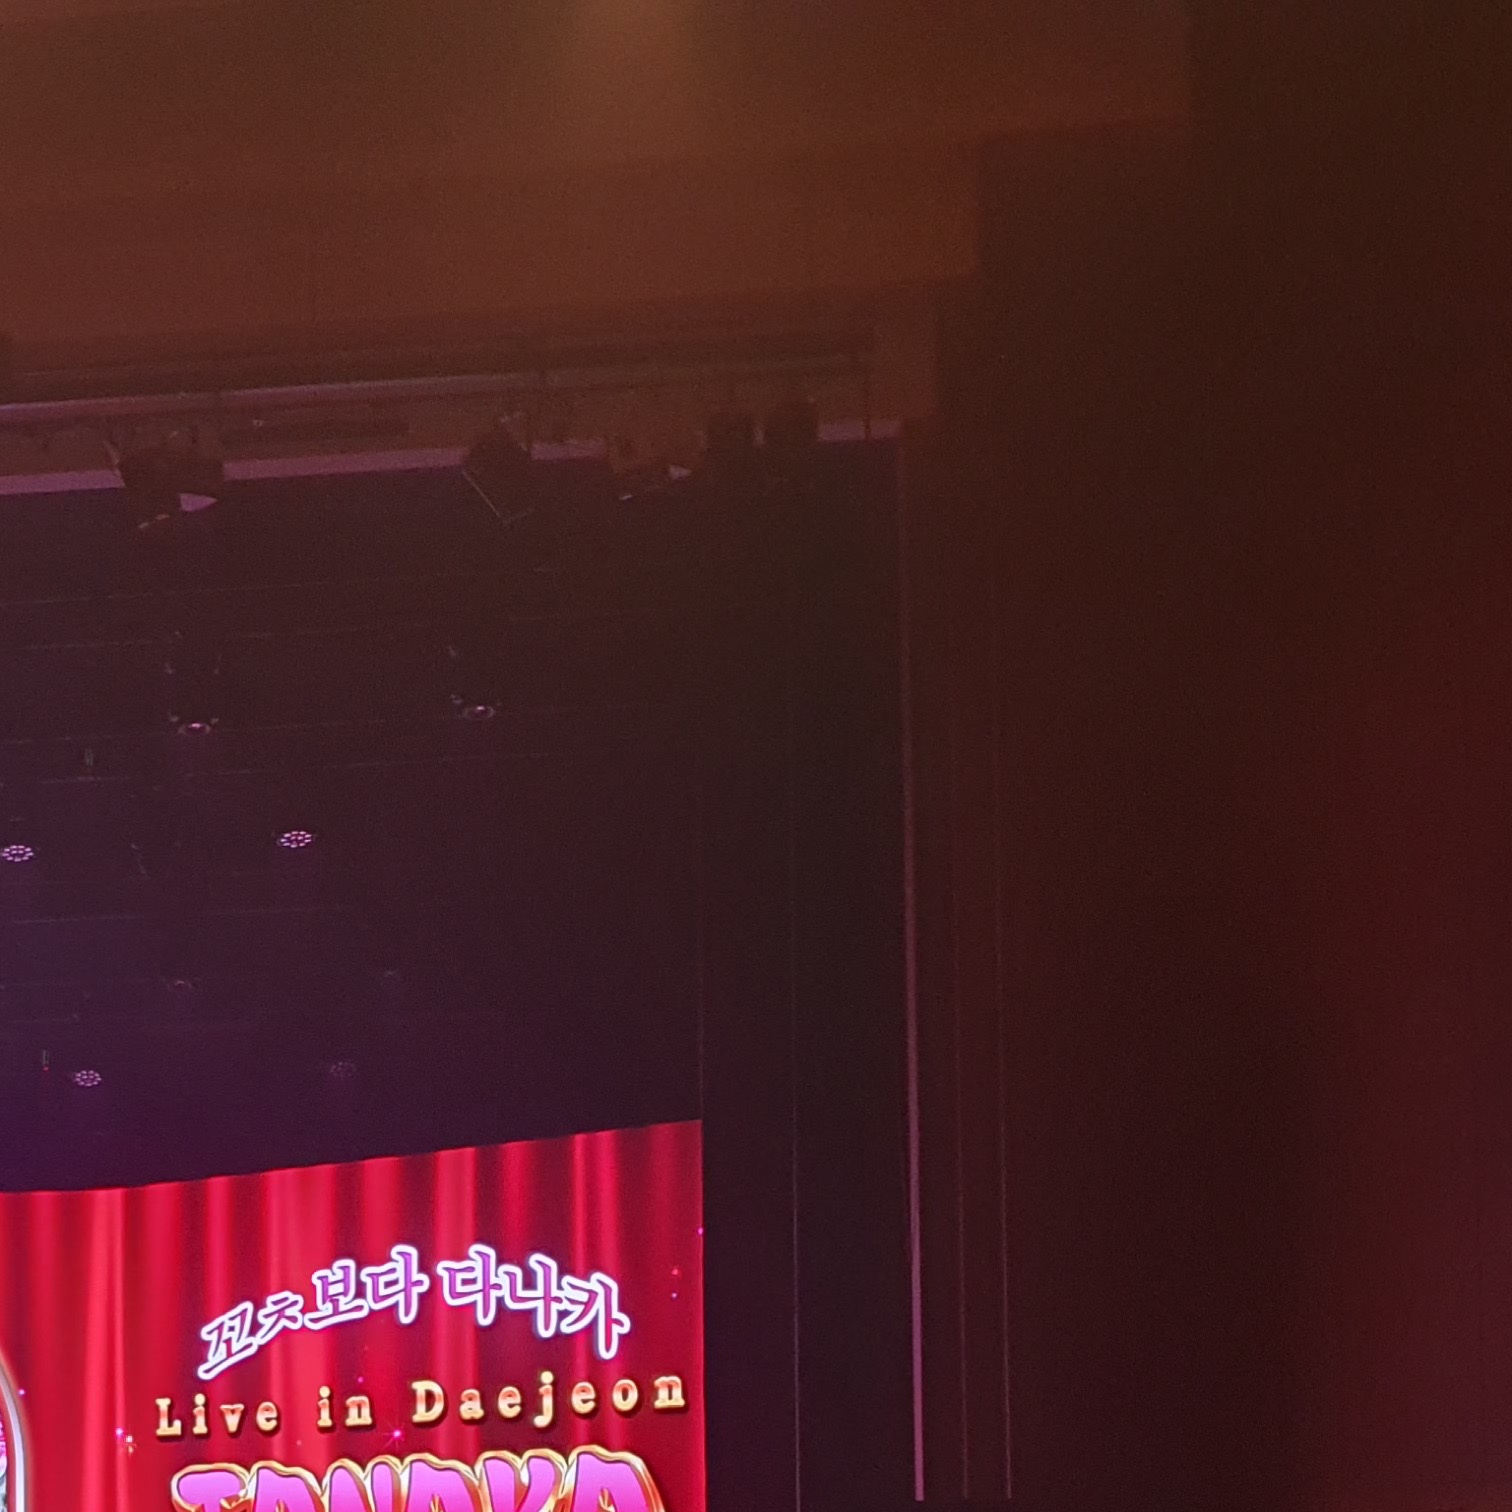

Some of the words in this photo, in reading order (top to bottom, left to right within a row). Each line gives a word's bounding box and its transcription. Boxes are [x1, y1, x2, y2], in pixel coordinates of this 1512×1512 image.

[437, 1244, 631, 1361] 다나카
[155, 1393, 281, 1438] Live
[317, 1386, 372, 1428] in
[411, 1371, 686, 1428] Daejeon
